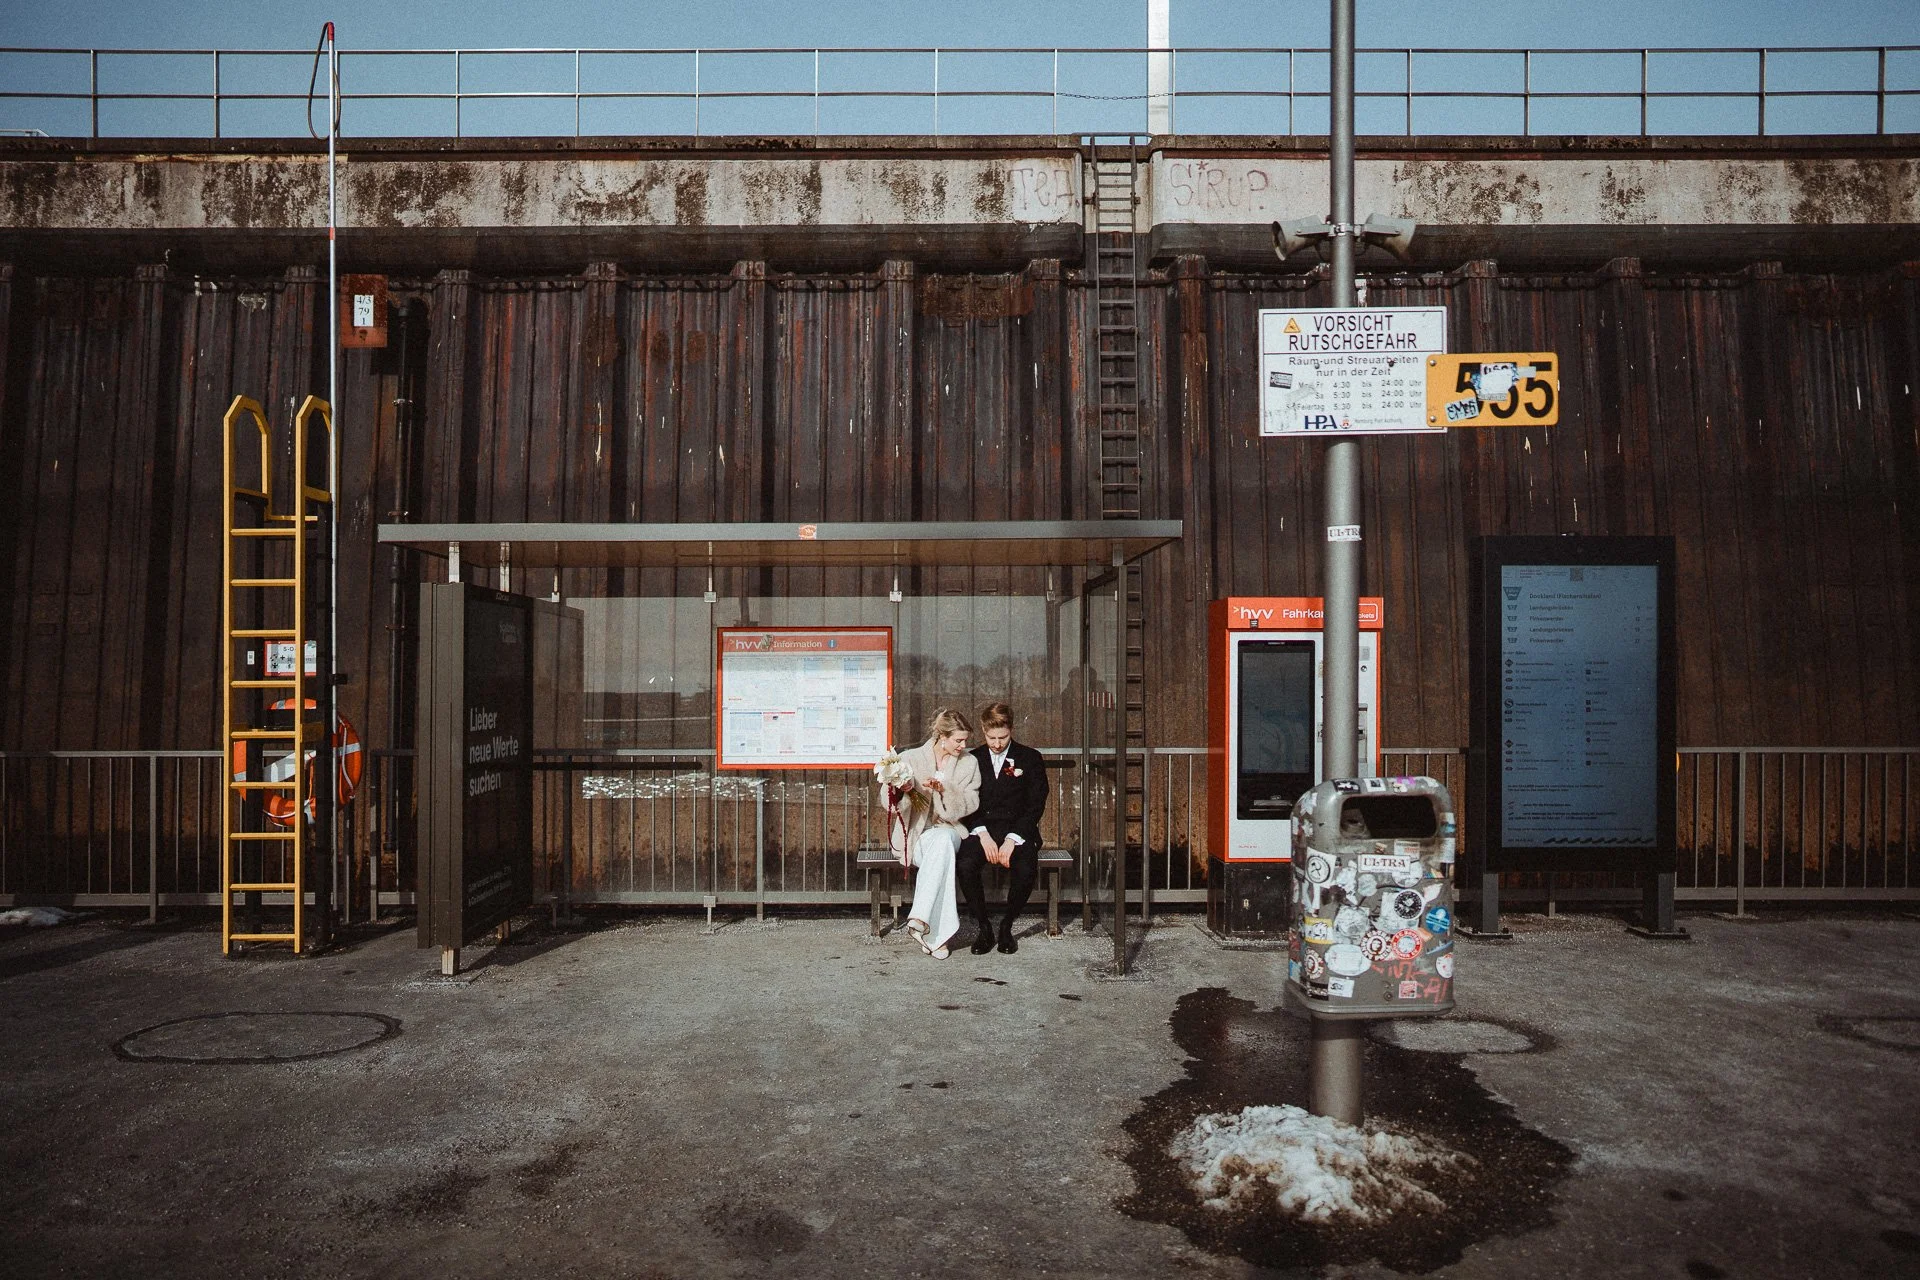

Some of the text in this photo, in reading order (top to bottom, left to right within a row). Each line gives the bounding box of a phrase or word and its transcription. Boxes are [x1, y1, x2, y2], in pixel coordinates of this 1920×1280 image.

[358, 307, 370, 315] 79
[1313, 314, 1394, 332] VORSICHT
[1288, 333, 1417, 351] RUTSCHGEFAHR
[1347, 355, 1419, 365] Streuarbeiten
[1337, 368, 1347, 377] in
[1350, 367, 1368, 376] der
[1371, 367, 1391, 376] Zeit
[1304, 415, 1338, 430] HPA
[1240, 606, 1274, 619] hvv
[773, 640, 823, 649] Information
[469, 706, 498, 732] Lieber
[469, 735, 519, 764] neue Werte
[469, 769, 501, 797] suchen
[1363, 857, 1407, 867] ULTRA
